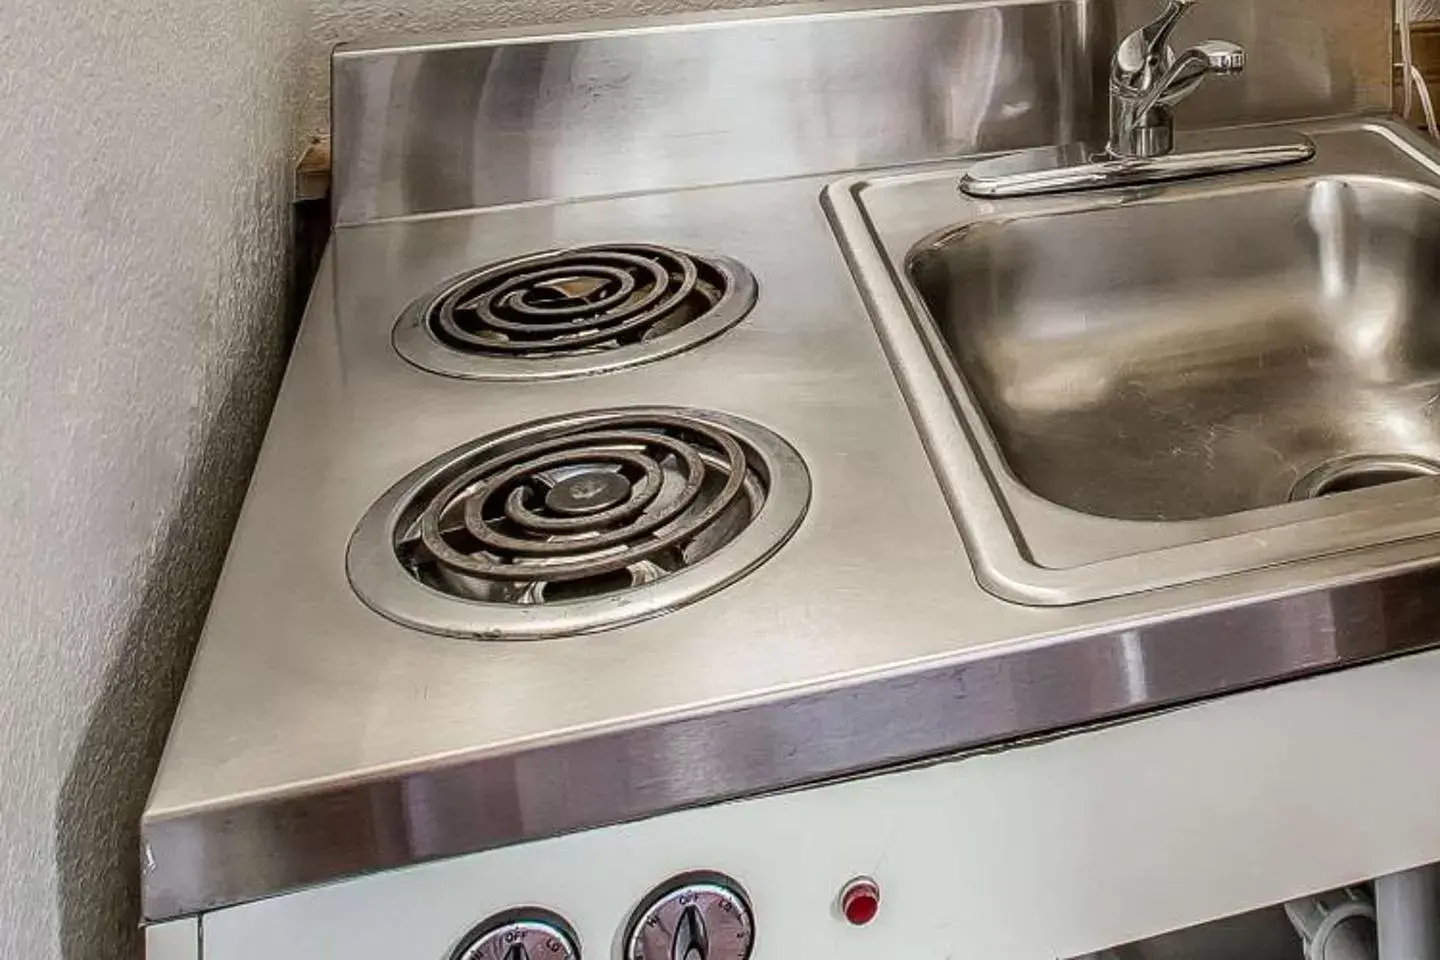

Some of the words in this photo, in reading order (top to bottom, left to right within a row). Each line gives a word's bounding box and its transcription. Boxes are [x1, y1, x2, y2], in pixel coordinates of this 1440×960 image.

[680, 892, 700, 905] OFF
[505, 929, 529, 943] OFF
[545, 938, 561, 953] LO
